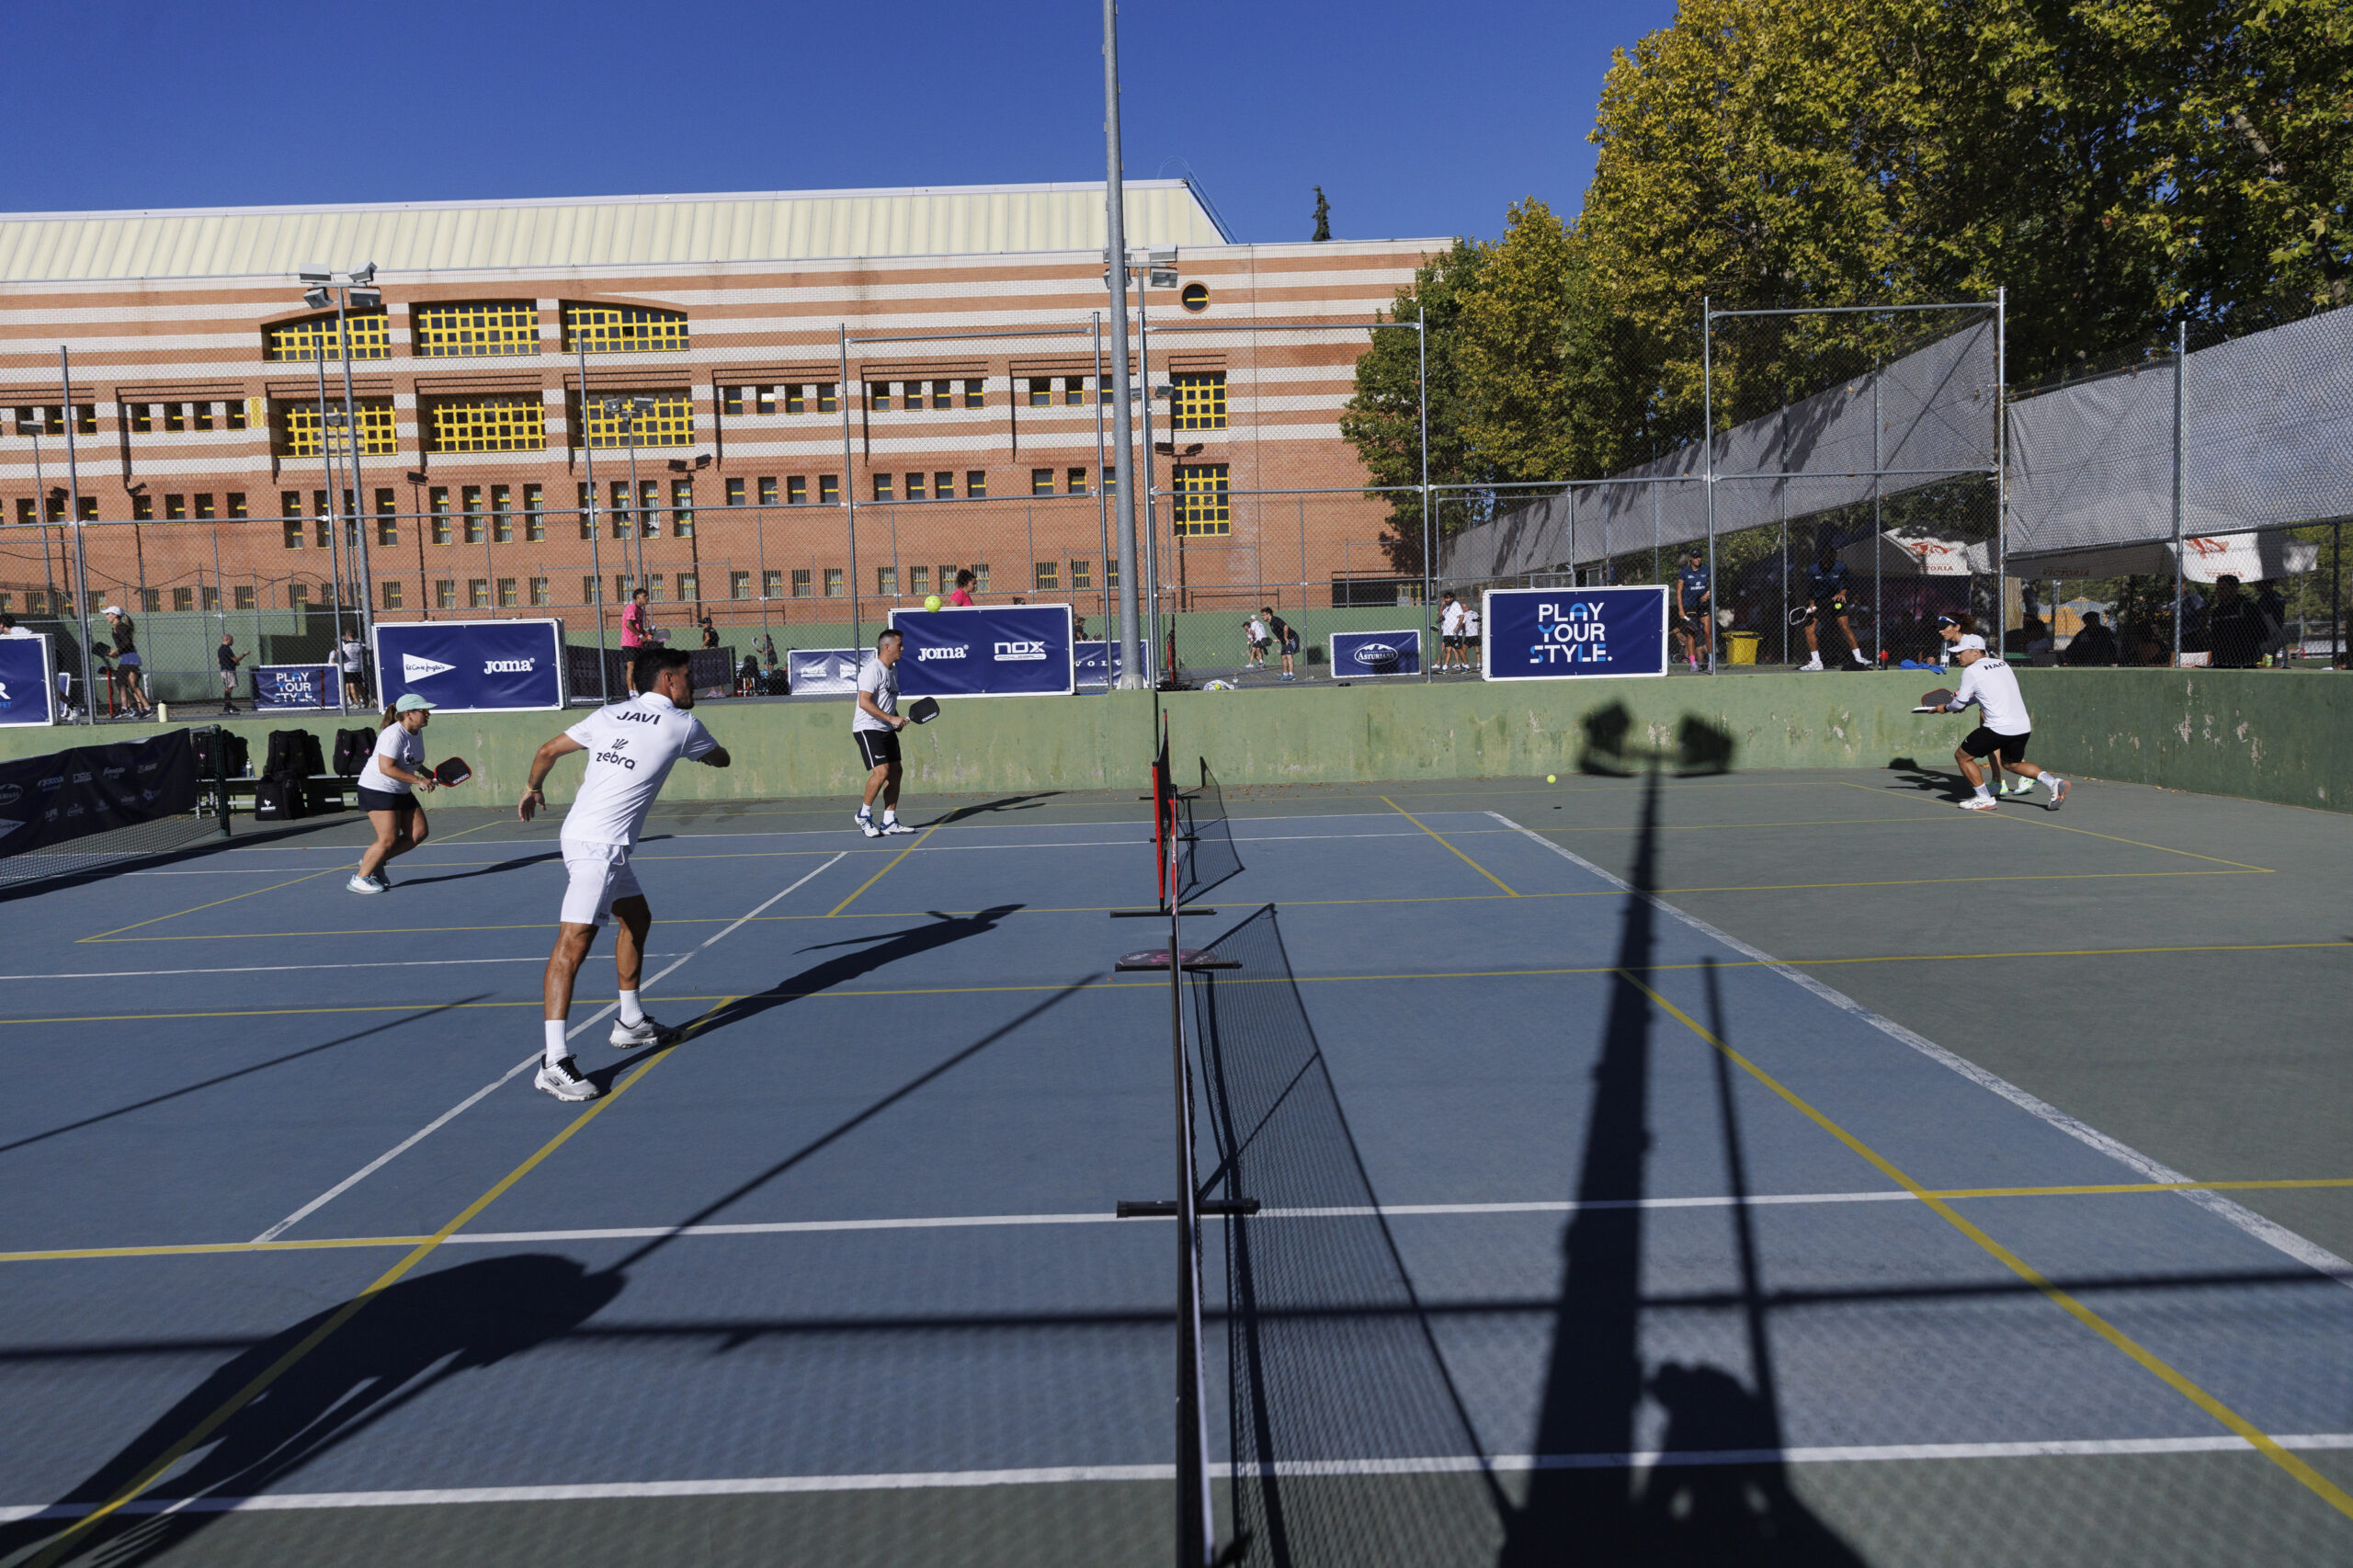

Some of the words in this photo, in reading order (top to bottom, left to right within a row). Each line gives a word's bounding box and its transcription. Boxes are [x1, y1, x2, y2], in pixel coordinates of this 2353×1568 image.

[1538, 602, 1605, 622] PLAY
[1538, 622, 1606, 642] YOUR
[1075, 659, 1121, 667] VOLV
[1984, 661, 2006, 670] HAO
[276, 672, 310, 682] PLAY
[277, 682, 312, 692] YOUR
[616, 711, 661, 725] JAVI
[596, 751, 636, 770] zebra
